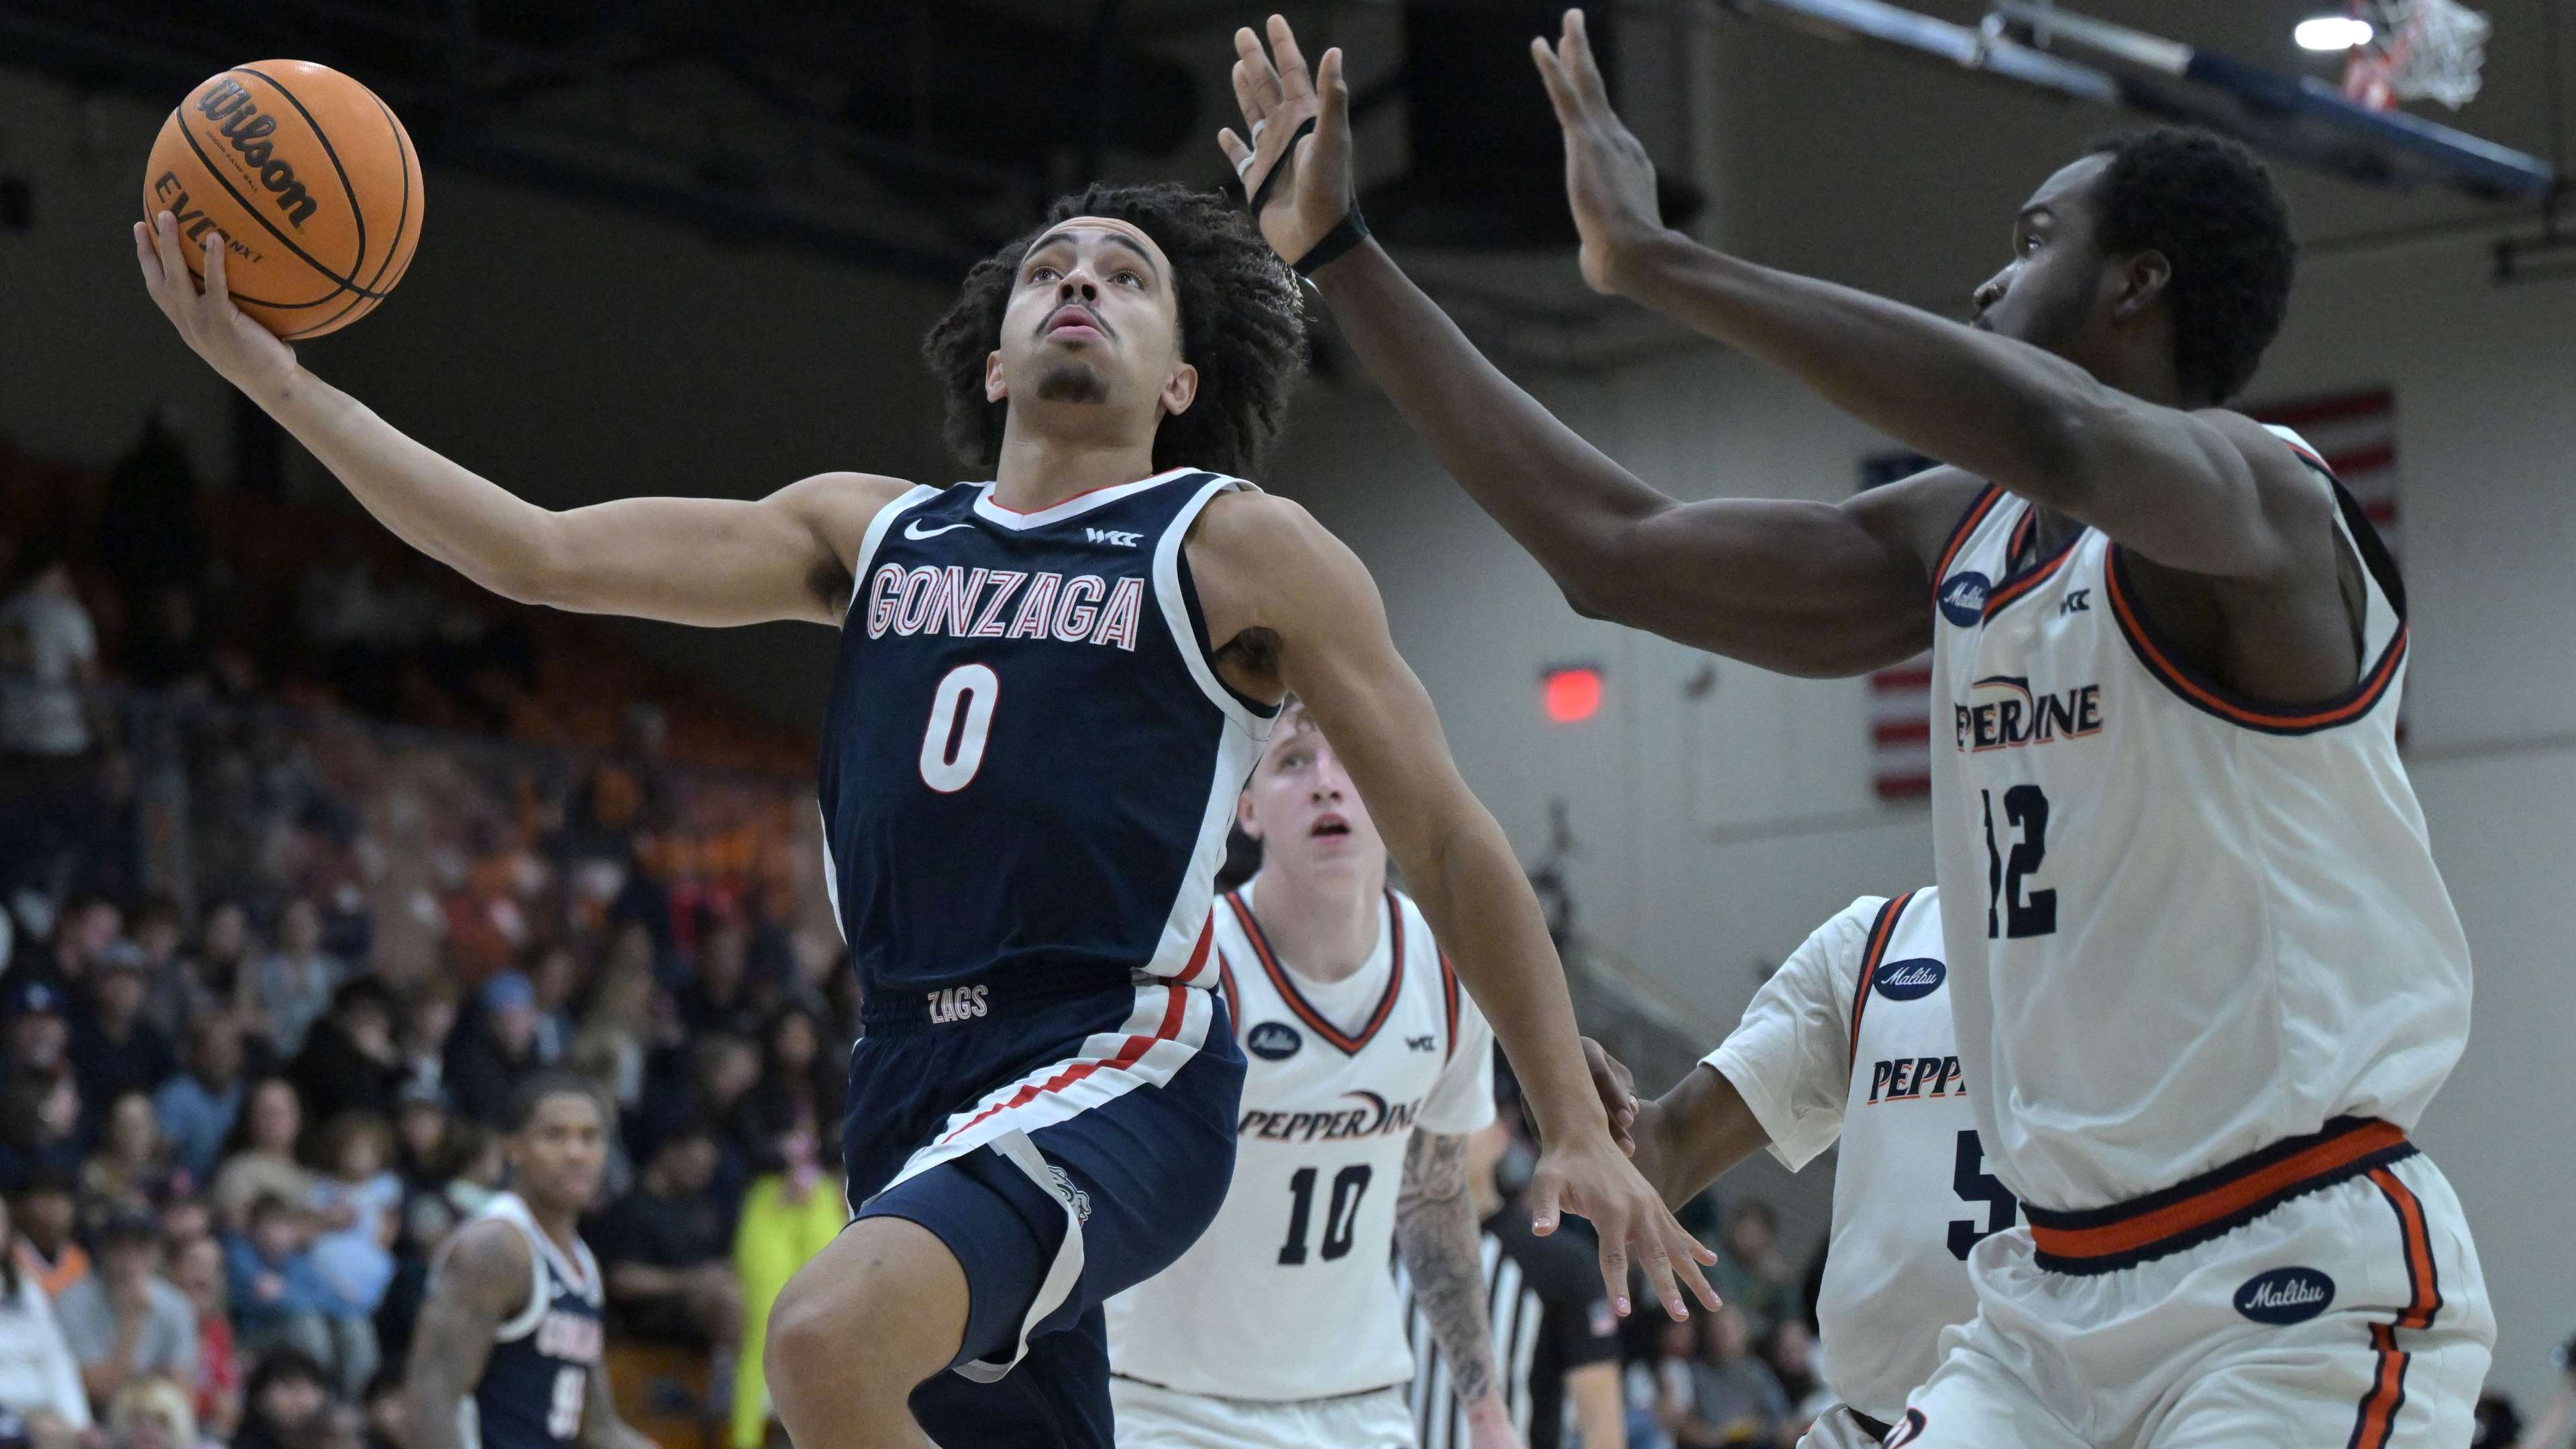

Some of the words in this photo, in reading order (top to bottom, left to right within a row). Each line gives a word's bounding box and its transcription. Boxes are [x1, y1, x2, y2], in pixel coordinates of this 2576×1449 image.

[197, 76, 317, 229] Wilson
[229, 239, 265, 264] NXT
[1085, 527, 1144, 547] WCC
[867, 562, 1144, 652] GONZAGA
[918, 661, 1001, 794] 0
[1981, 784, 2057, 939] 12
[1880, 966, 1937, 986] Malibu
[927, 984, 989, 1024] ZAGS
[1867, 1055, 1968, 1106] PEPP
[1236, 1090, 1421, 1144] PEPPERDIN
[1278, 1164, 1373, 1265] 10
[1947, 1129, 2018, 1261] 5
[2245, 1278, 2324, 1309] Malibu
